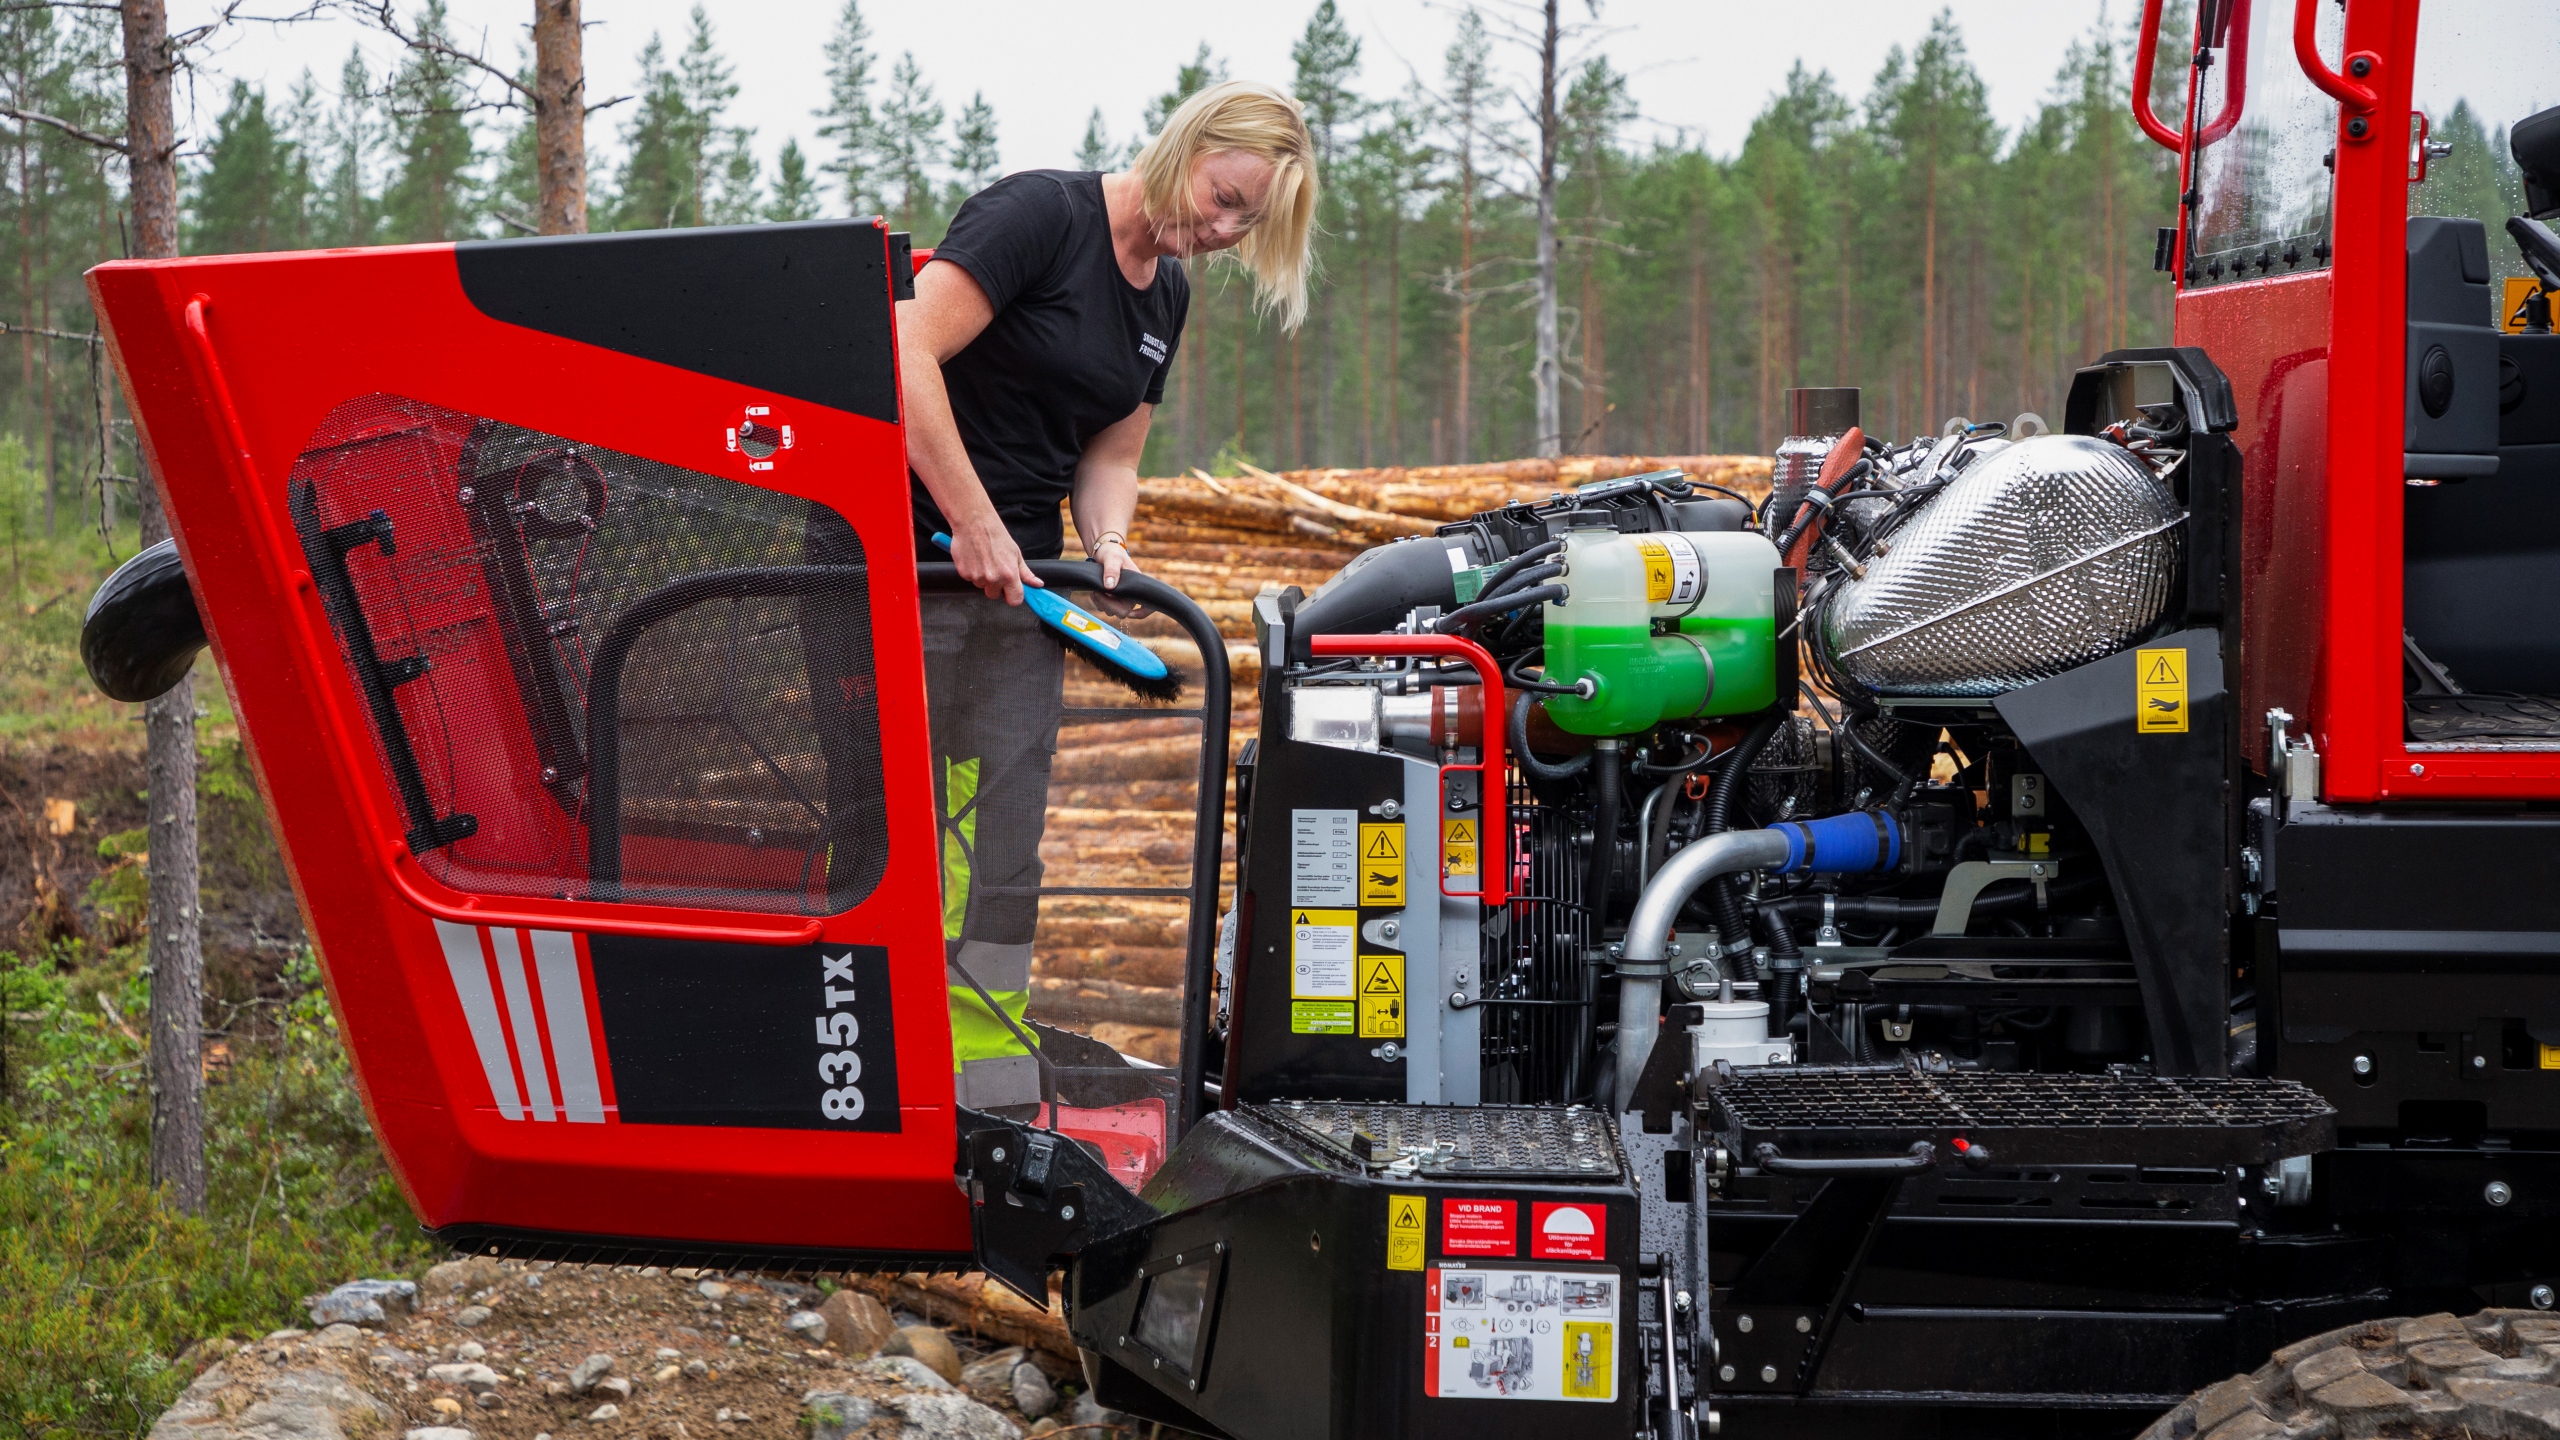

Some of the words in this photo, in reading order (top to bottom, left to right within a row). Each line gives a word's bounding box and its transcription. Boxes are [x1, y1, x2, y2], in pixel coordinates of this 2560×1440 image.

[815, 951, 865, 1121] 835TX
[1457, 1204, 1472, 1213] VID
[1473, 1204, 1503, 1214] BRAND
[1545, 1247, 1592, 1256] släckanläggning
[1438, 1261, 1467, 1269] KOMATSU
[1430, 1284, 1437, 1296] 1
[1429, 1336, 1437, 1348] 2
